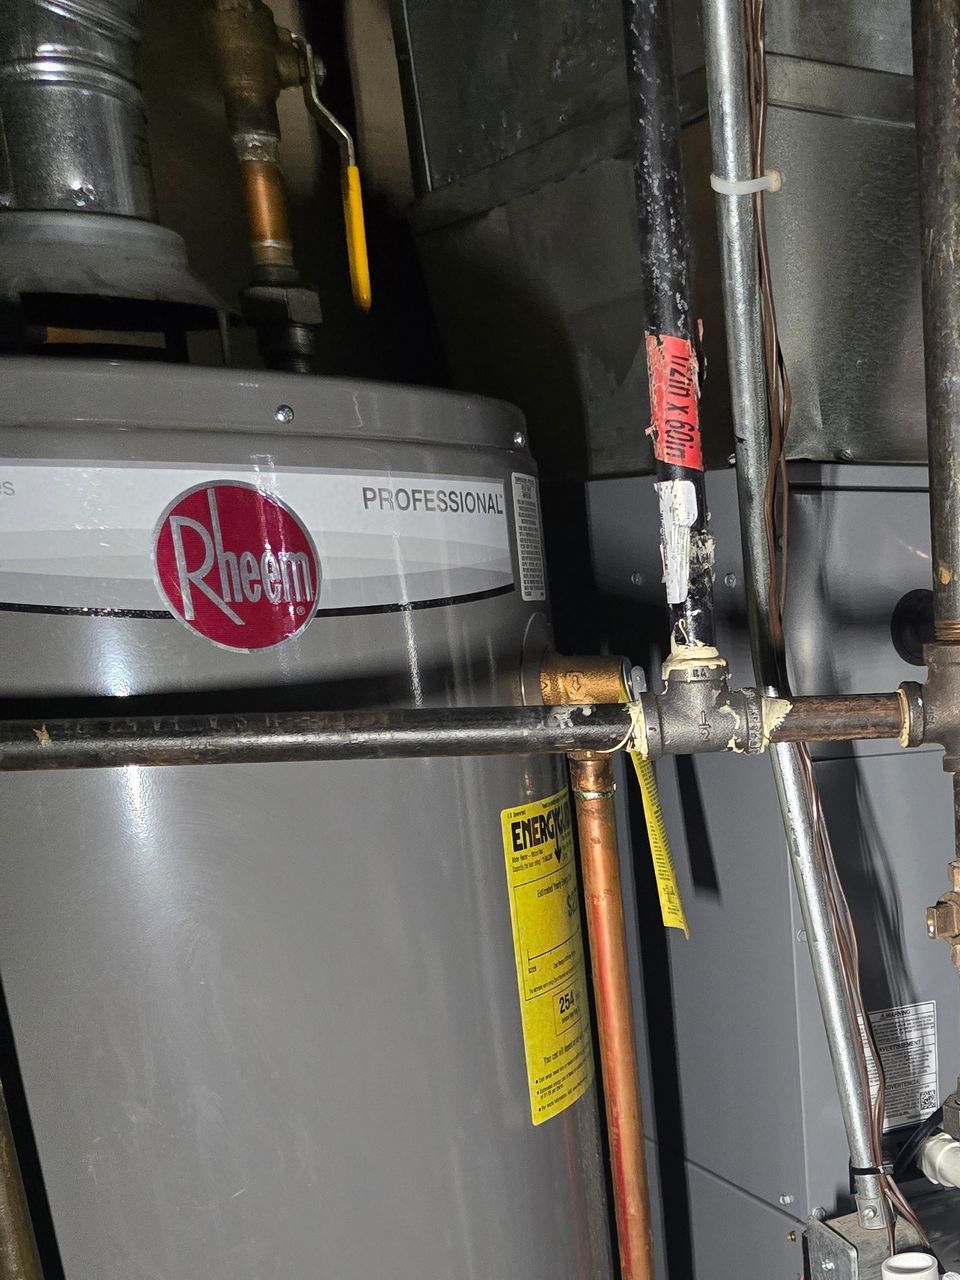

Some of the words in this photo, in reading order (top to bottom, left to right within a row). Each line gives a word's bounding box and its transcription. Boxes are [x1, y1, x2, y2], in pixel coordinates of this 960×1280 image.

[668, 403, 690, 415] x
[665, 419, 695, 458] 60in
[0, 481, 15, 496] s
[363, 486, 503, 515] PROFESSIONAL
[169, 488, 315, 625] Rheem
